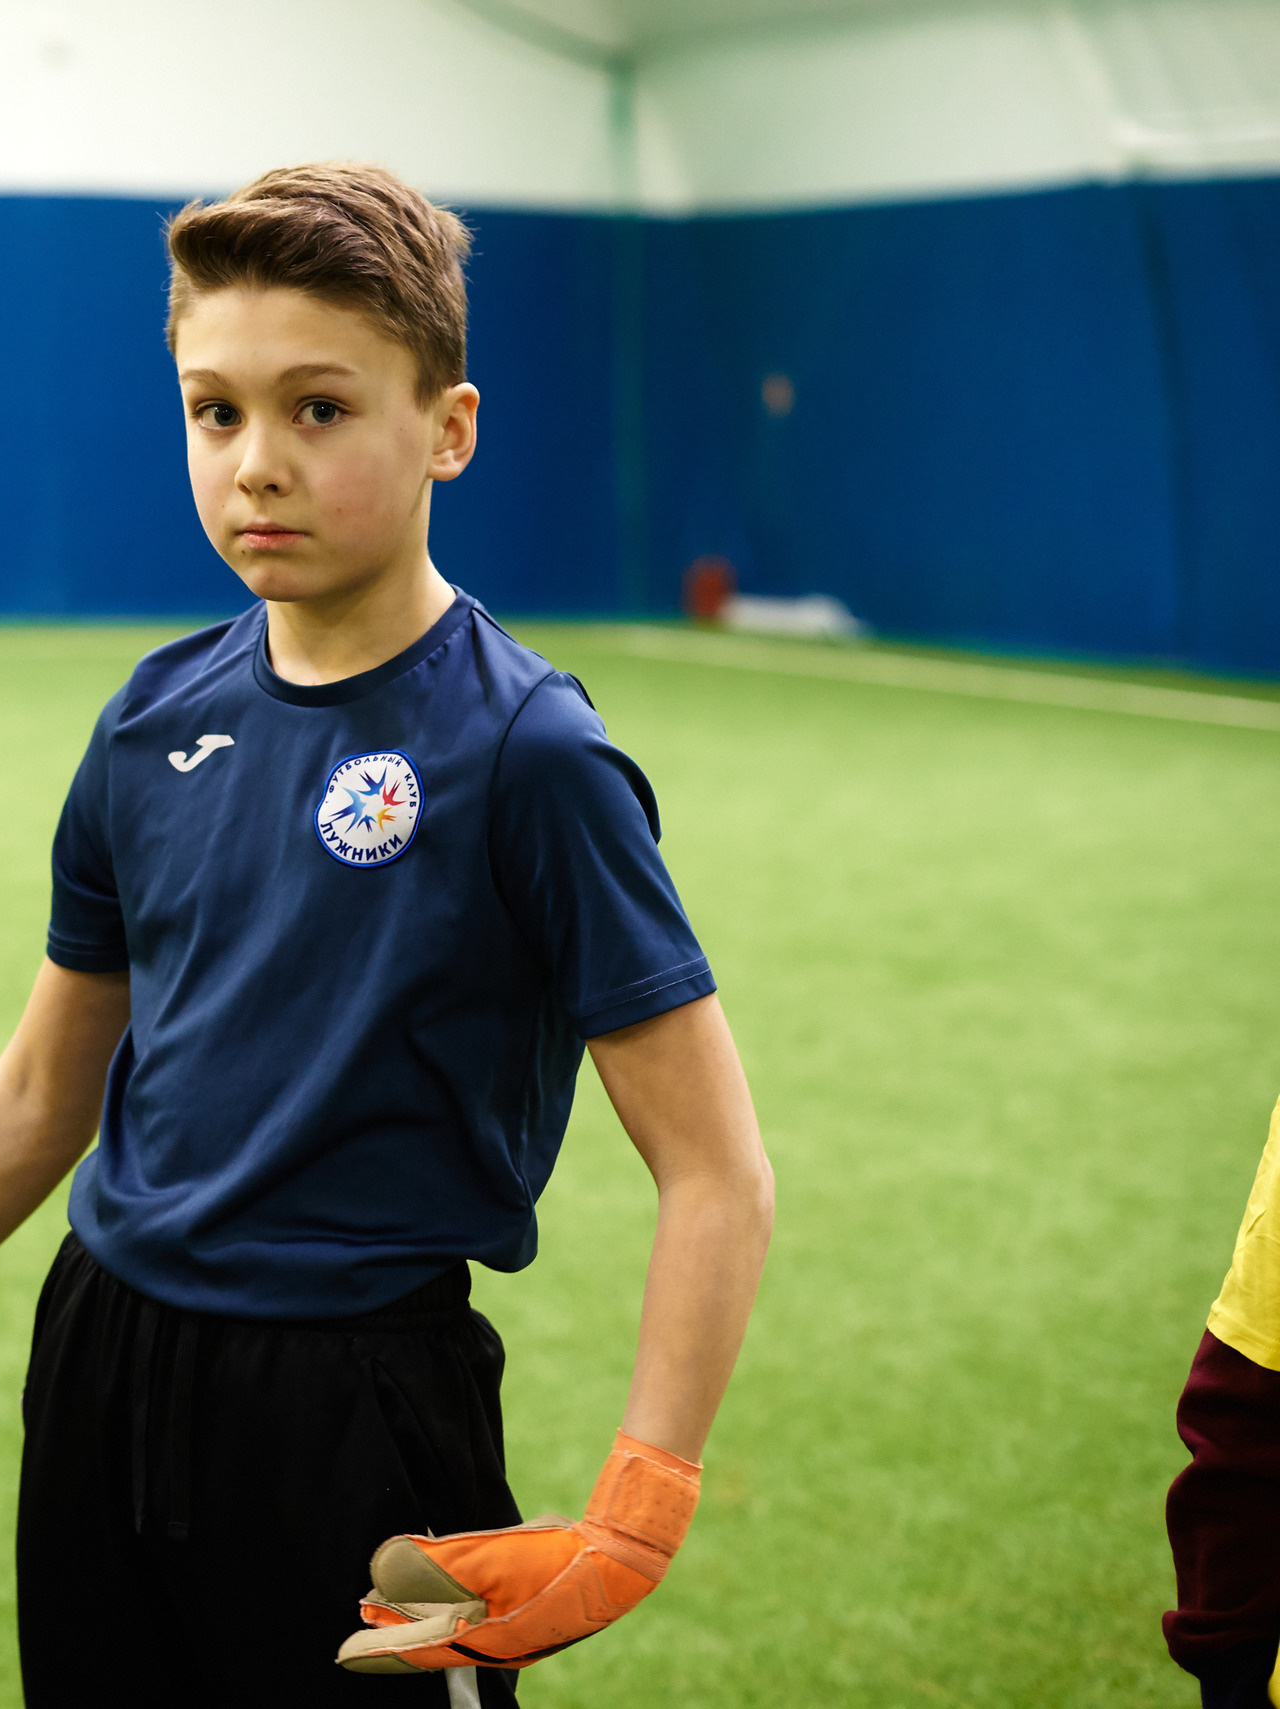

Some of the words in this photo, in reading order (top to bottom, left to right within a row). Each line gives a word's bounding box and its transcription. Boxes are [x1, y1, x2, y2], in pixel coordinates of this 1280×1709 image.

[328, 755, 403, 794] ФУТБОЛЬНЫЙ
[404, 772, 418, 808] КЛУБ
[320, 822, 404, 861] ЛУЖНИКИ
